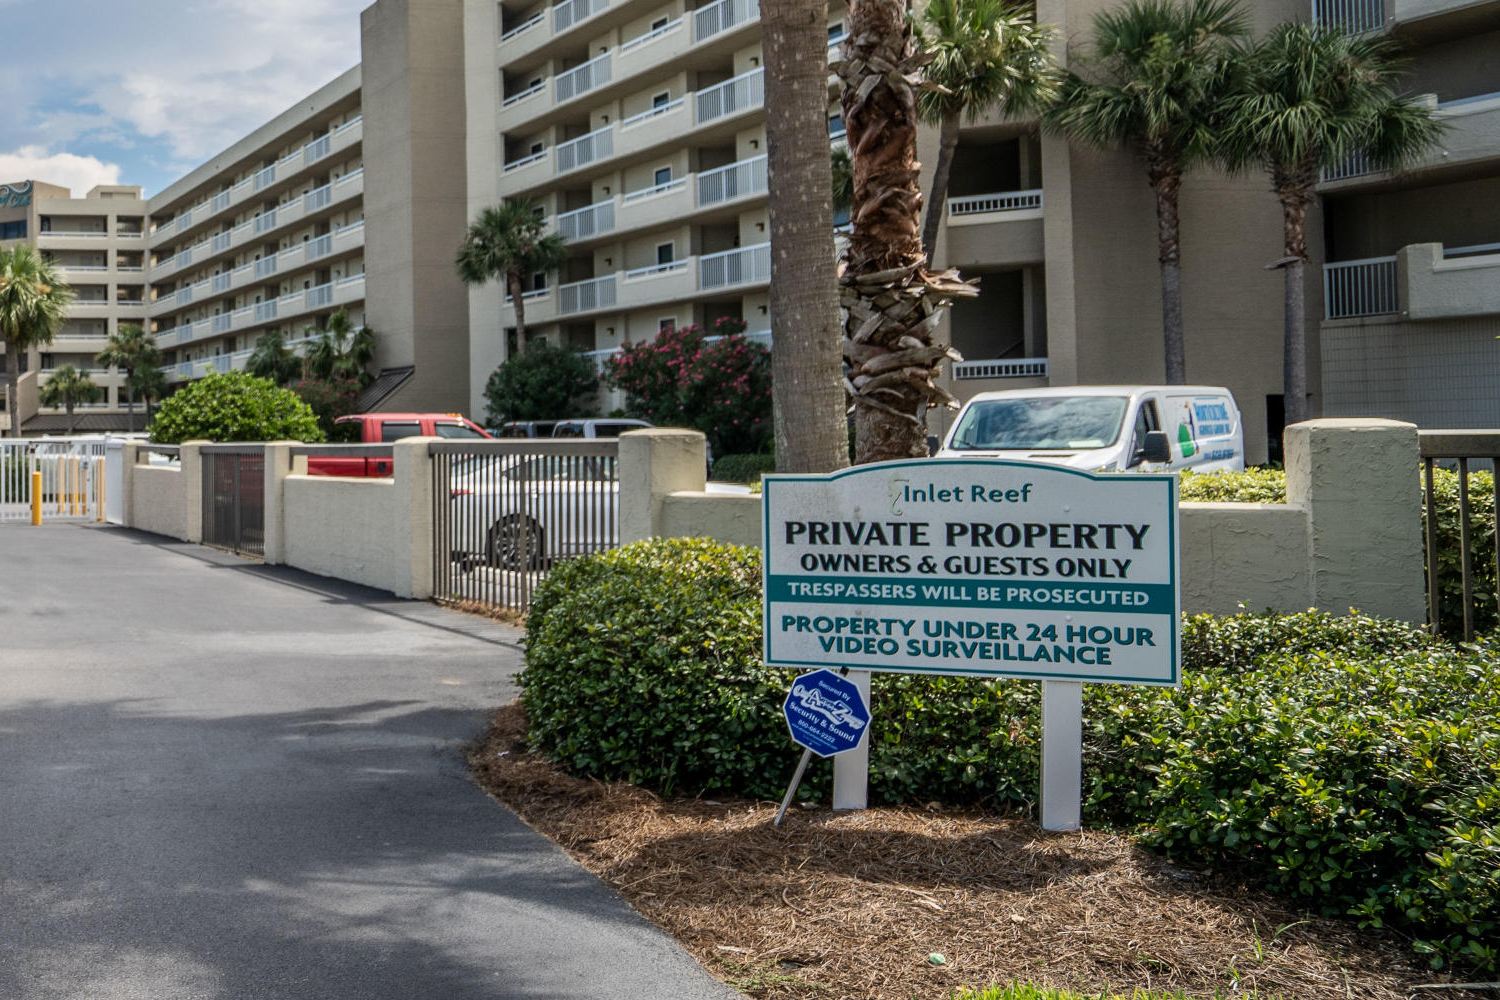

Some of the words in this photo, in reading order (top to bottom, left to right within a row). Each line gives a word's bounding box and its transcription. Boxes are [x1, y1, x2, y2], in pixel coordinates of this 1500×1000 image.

[904, 483, 964, 502] Inlet
[971, 483, 1033, 503] Reef
[785, 521, 930, 547] PRIVATE
[945, 522, 1150, 550] PROPERTY
[800, 553, 912, 574] OWNERS
[917, 555, 938, 574] &
[944, 556, 1050, 576] GUESTS
[1055, 557, 1132, 579] ONLY
[787, 582, 917, 600] TRESPASSERS
[922, 585, 972, 601] WILL
[977, 587, 1001, 602] BE
[1007, 588, 1150, 606] PROSECUTED
[782, 615, 916, 637] PROPERTY
[923, 620, 1020, 641] UNDER
[1026, 623, 1058, 643] 24
[1066, 625, 1156, 647] HOUR
[818, 635, 899, 656] VIDEO
[906, 639, 1112, 666] SURVEILLANCE
[818, 680, 842, 697] Secured
[842, 691, 851, 702] By
[789, 701, 820, 724] Security
[820, 719, 828, 728] &
[828, 723, 856, 742] Sound
